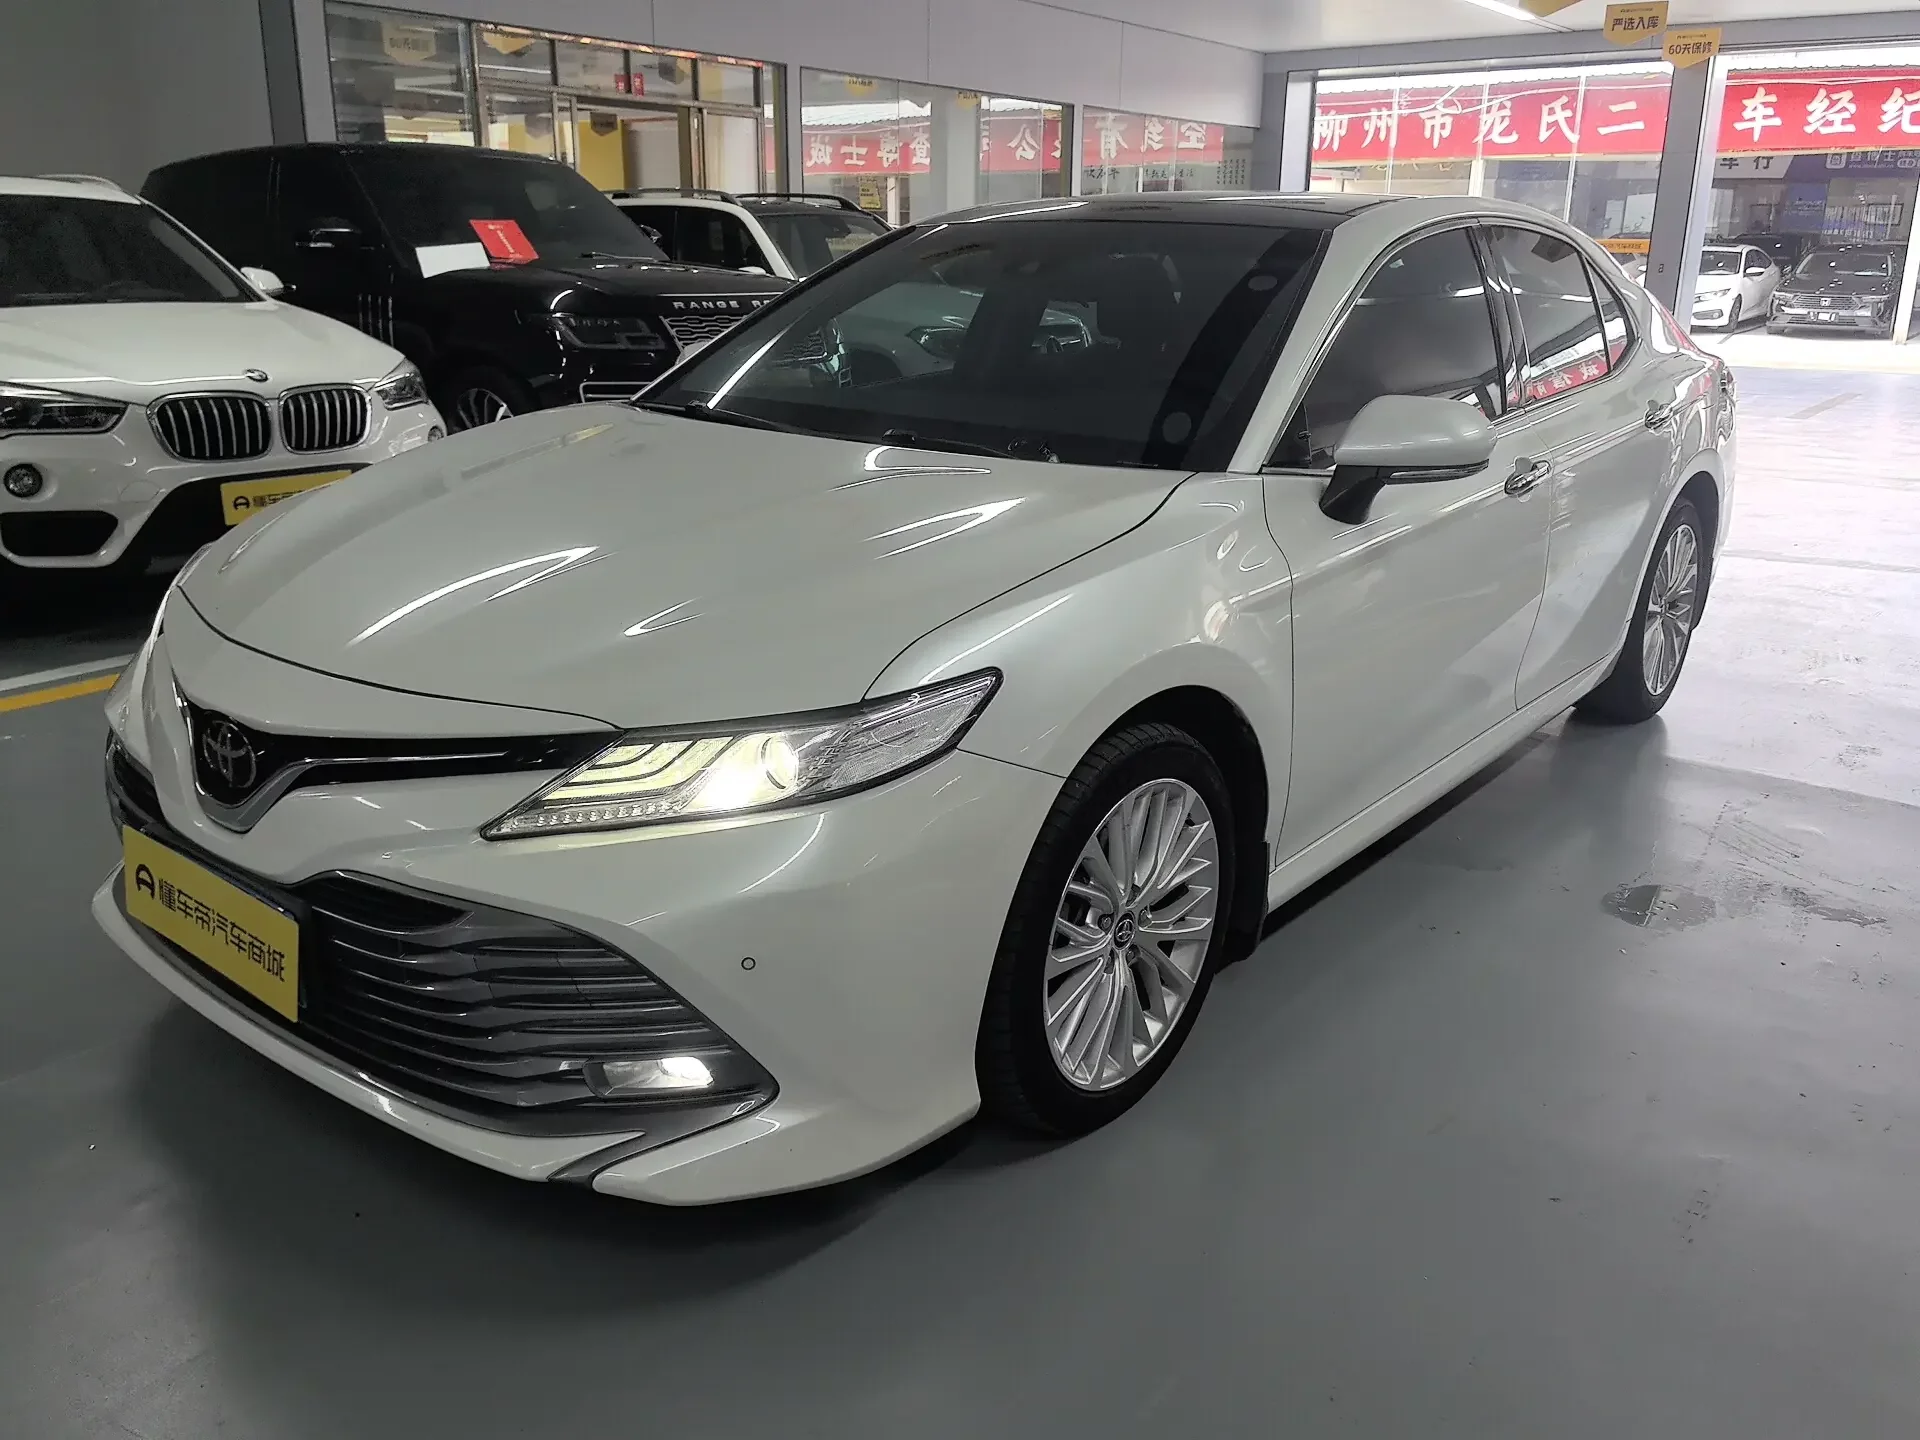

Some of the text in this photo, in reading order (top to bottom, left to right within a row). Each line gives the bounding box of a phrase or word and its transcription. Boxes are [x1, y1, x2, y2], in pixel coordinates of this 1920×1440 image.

[1611, 16, 1660, 32] 严选入库
[1668, 41, 1713, 55] 60天保修
[673, 300, 740, 310] RANGE
[158, 878, 286, 983] 懂车帝汽车商城
